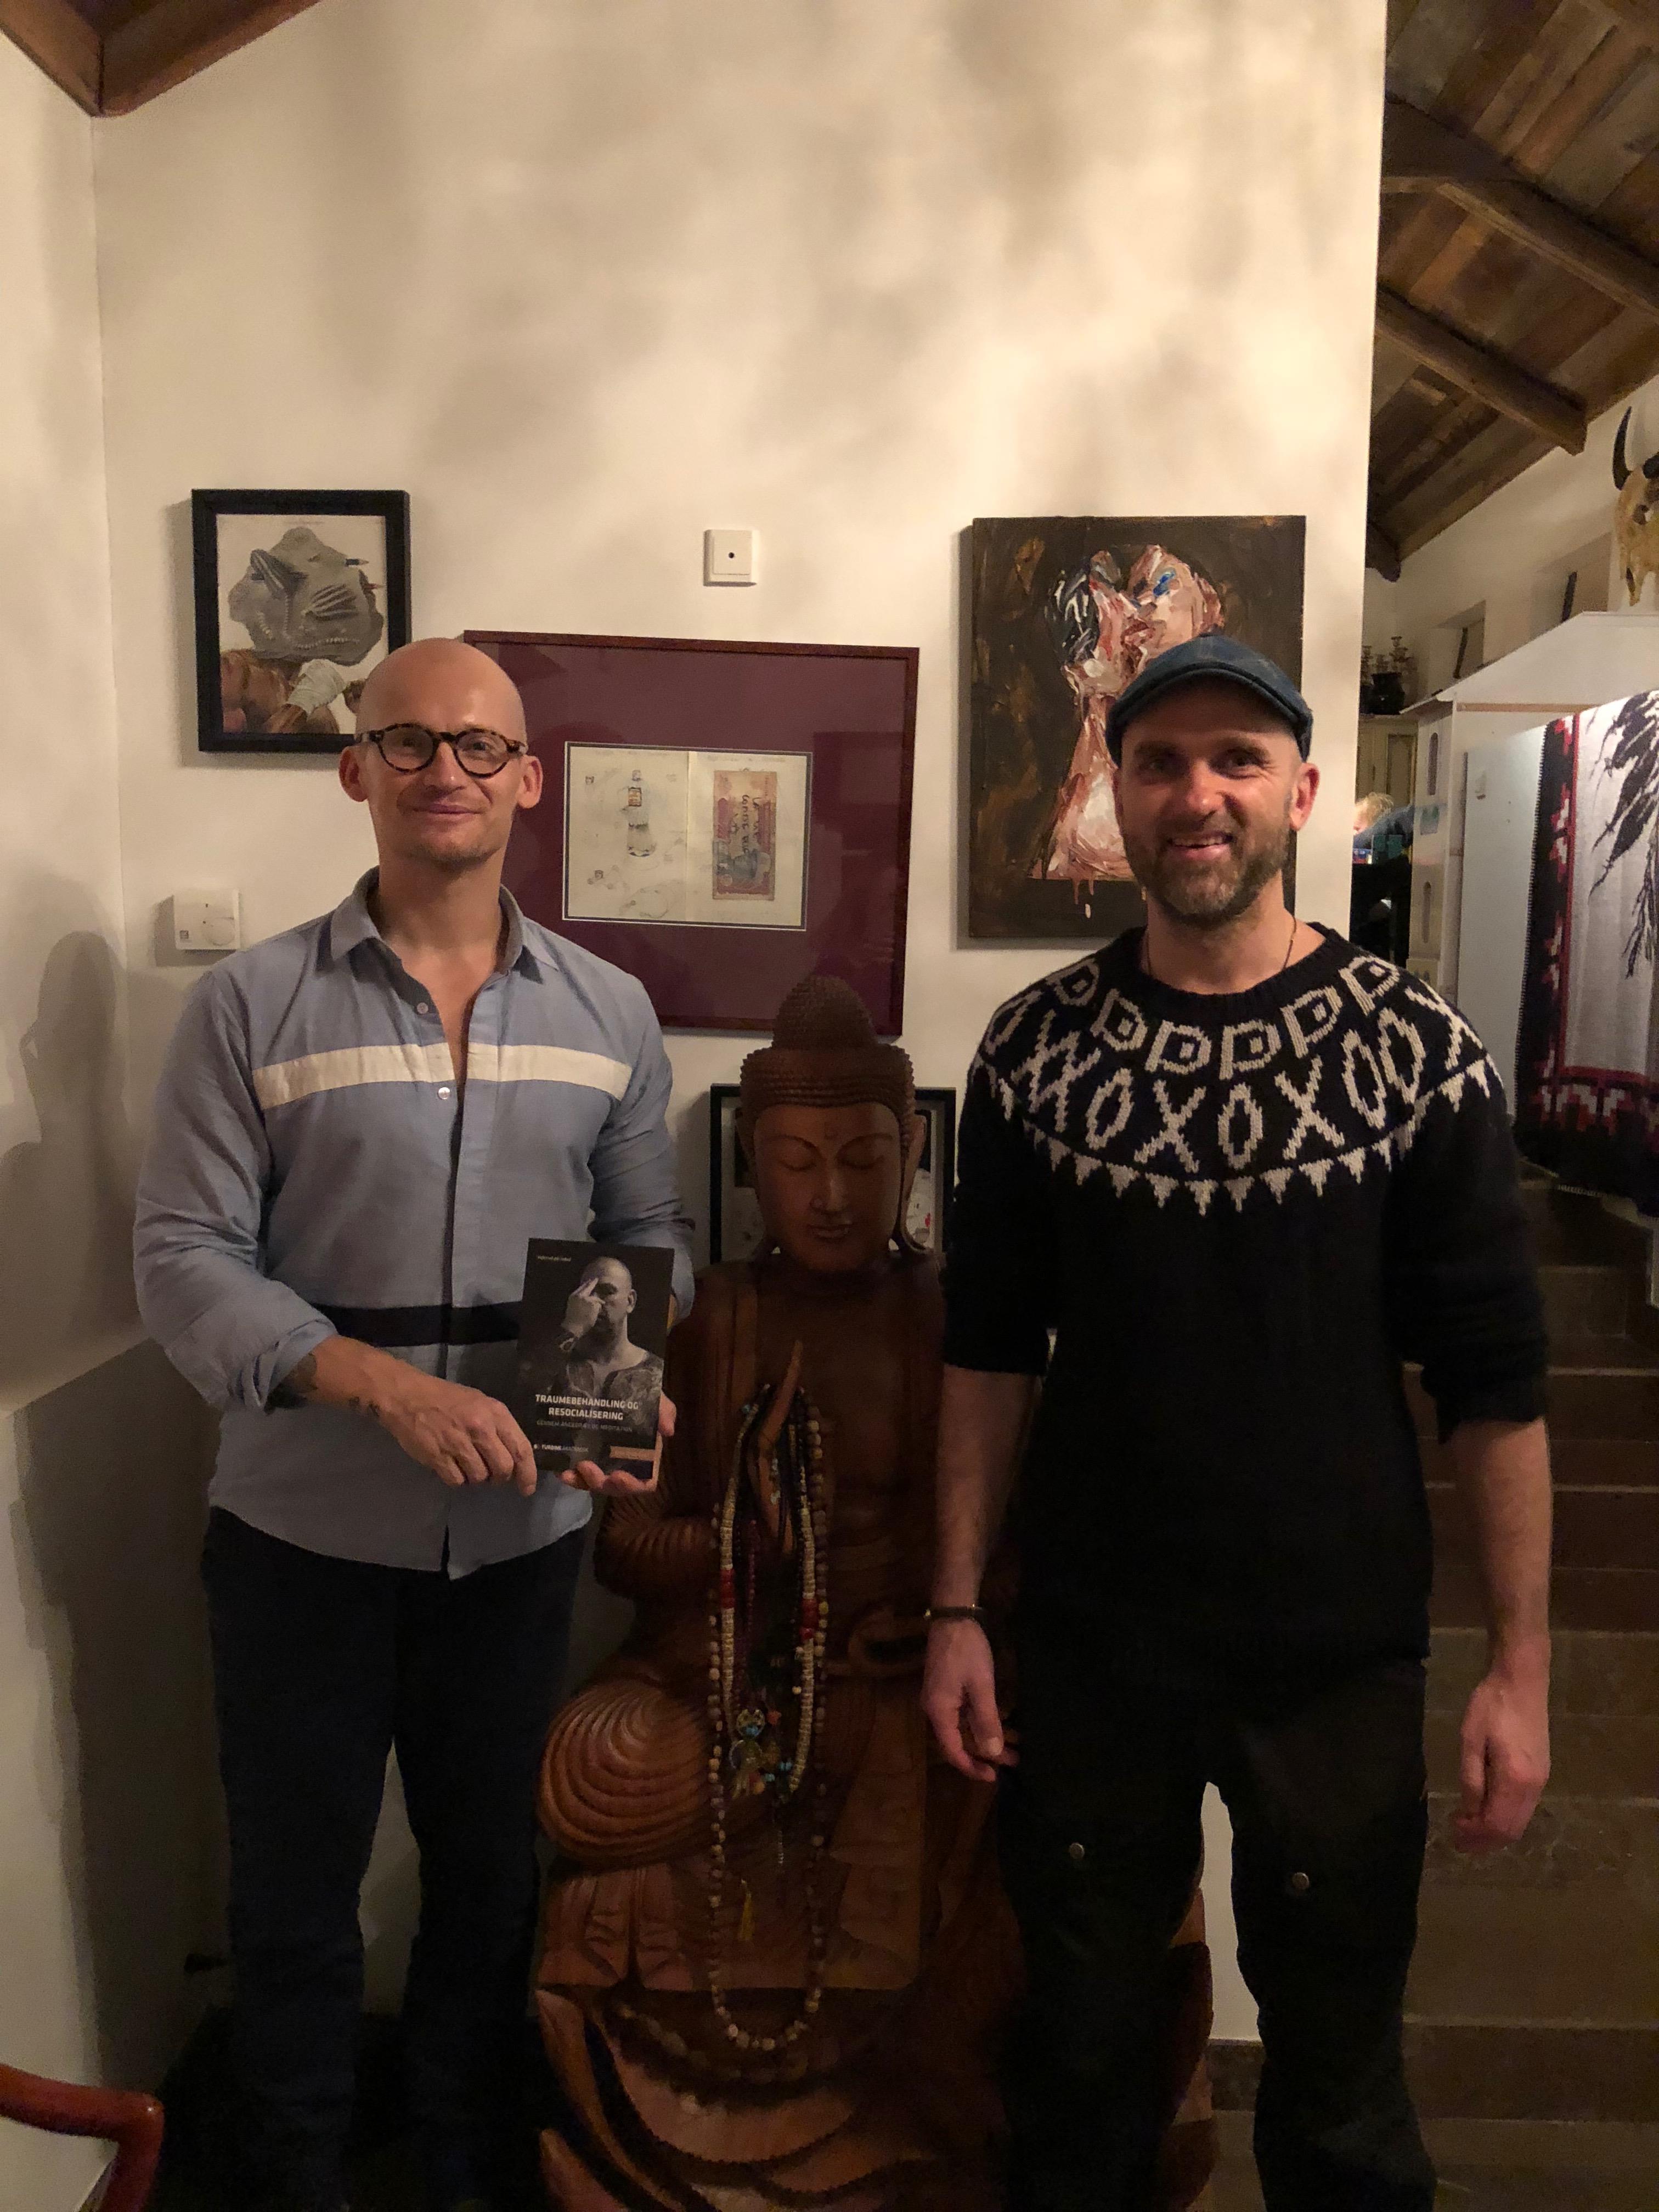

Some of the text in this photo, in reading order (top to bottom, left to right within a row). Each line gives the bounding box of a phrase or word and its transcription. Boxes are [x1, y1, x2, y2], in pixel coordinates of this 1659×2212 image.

[535, 1394, 639, 1410] TRAUMEBEHANDLING OG
[548, 1407, 624, 1420] RESOCIALISERING
